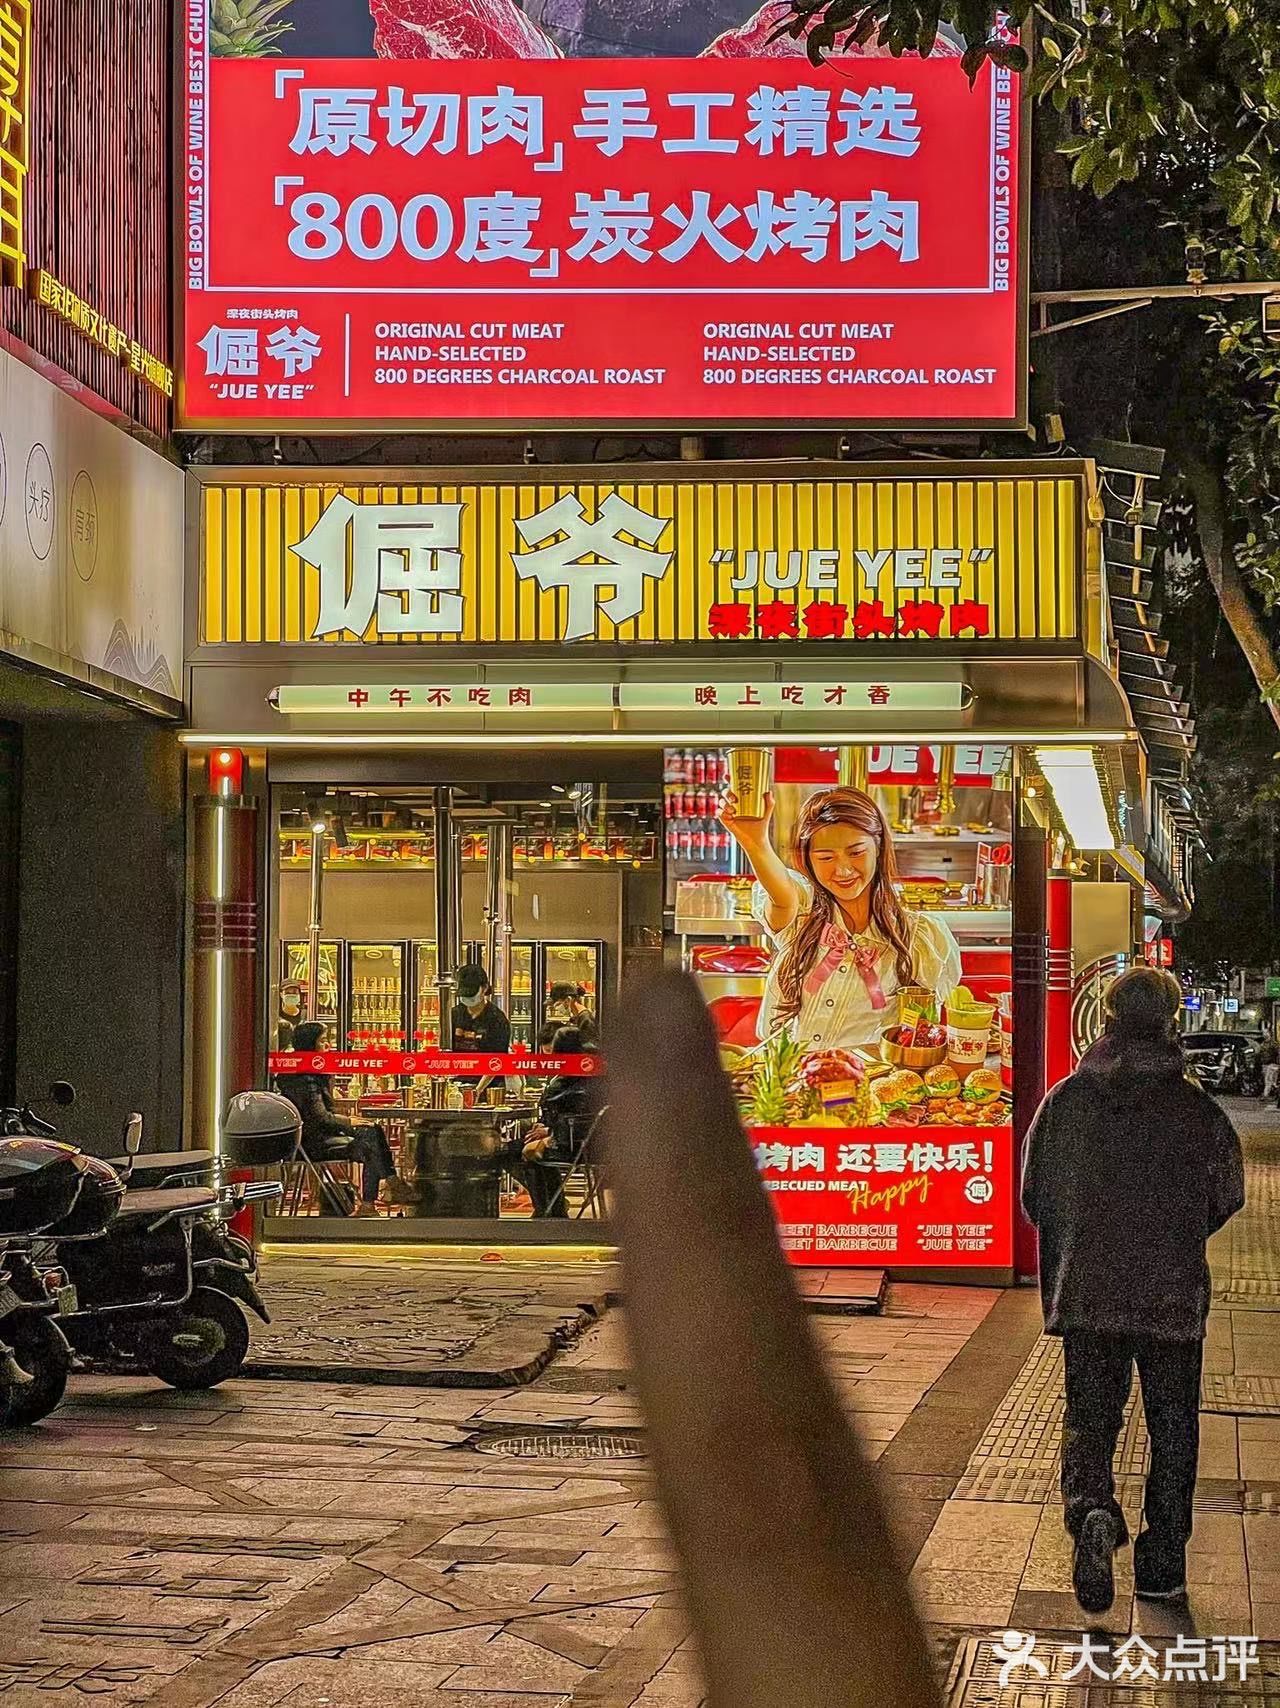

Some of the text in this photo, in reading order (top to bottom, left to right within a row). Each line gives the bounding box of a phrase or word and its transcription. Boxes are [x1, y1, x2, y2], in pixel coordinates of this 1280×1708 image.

[189, 47, 203, 94] BEST
[189, 98, 203, 151] WINE
[188, 154, 203, 181] OF
[994, 64, 1011, 291] BIG BOWLS OF WINE BE
[188, 185, 203, 253] BOWLS
[188, 257, 203, 290] BIG
[374, 322, 565, 339] ORIGINAL CUT MEAT
[702, 322, 895, 339] ORIGINAL CUT MEAT
[196, 324, 323, 379] 倔爷
[374, 345, 527, 362] HAND-SELECTED
[702, 345, 856, 362] HAND-SELECTED
[374, 368, 666, 385] 800 DEGREES CHARCOAL ROAST
[702, 368, 997, 385] 800 DEGREES CHARCOAL ROAST
[288, 491, 676, 644] 倔爷
[348, 687, 533, 708] 中午不吃肉
[694, 685, 891, 707] 晚上吃才香
[827, 1180, 866, 1191] MEAT
[846, 1174, 934, 1215] Happy
[815, 1223, 899, 1237] BARBECUE
[815, 1237, 899, 1251] BARBECUE
